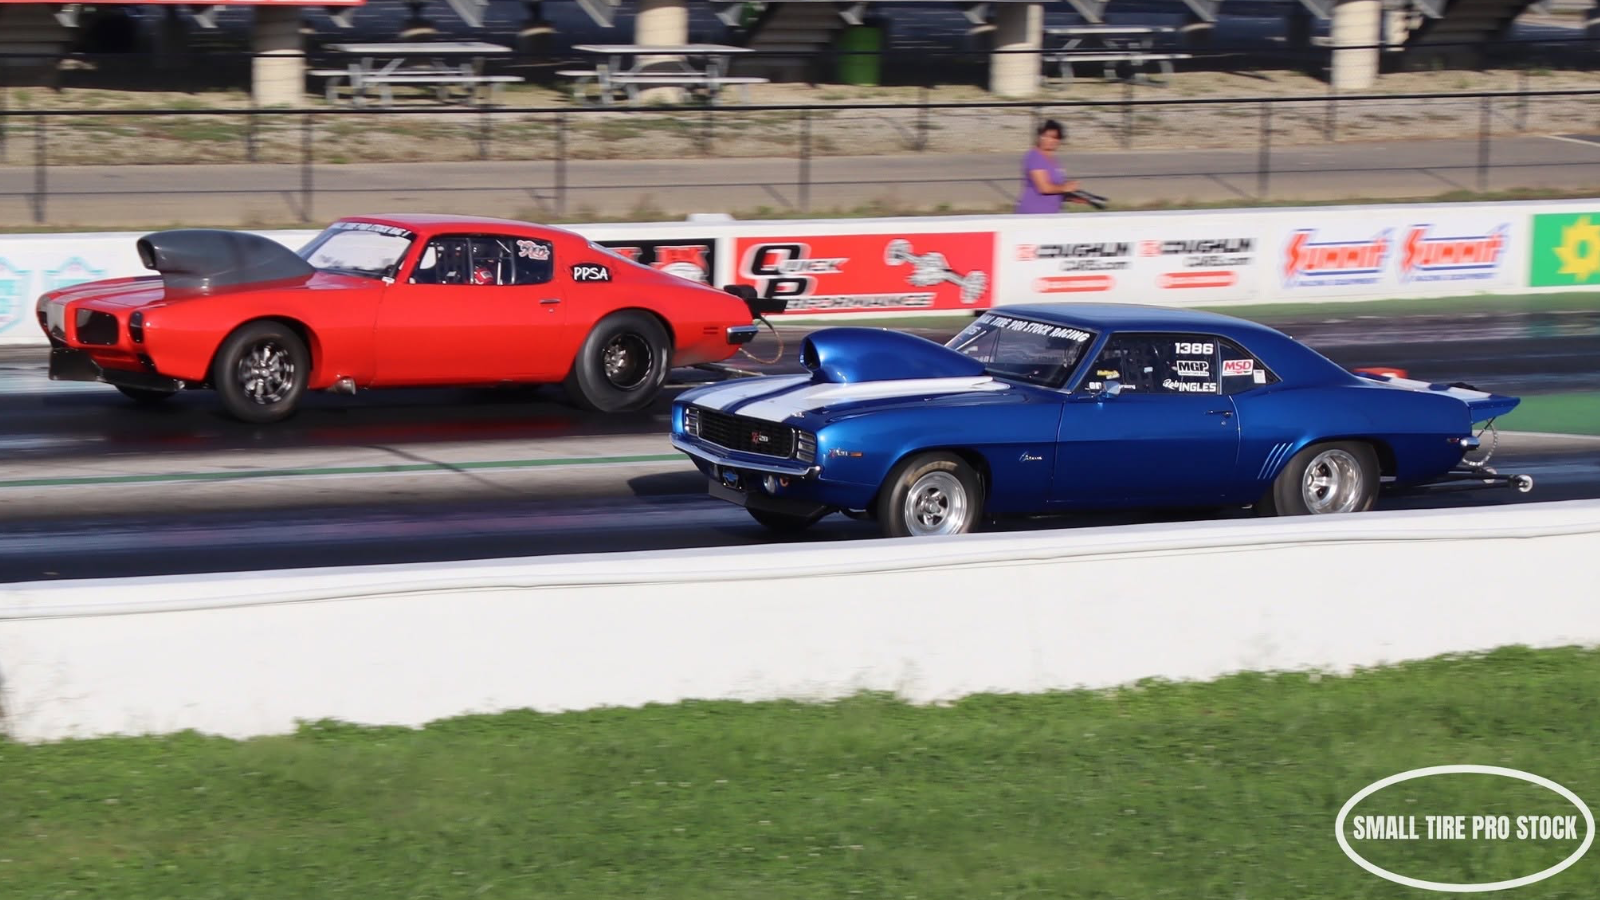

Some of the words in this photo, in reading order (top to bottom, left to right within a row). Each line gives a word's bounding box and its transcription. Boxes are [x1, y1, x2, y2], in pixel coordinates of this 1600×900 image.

[573, 266, 609, 281] PPSA
[757, 276, 935, 310] PRFORMANCE
[990, 316, 1012, 328] TIRE
[1006, 319, 1028, 331] PRO
[1022, 322, 1054, 336] STOCK
[1049, 327, 1090, 342] RACING
[1174, 342, 1214, 354] 1386
[1178, 361, 1209, 372] MGP
[1224, 360, 1252, 370] MSD
[1178, 382, 1217, 392] INGLES
